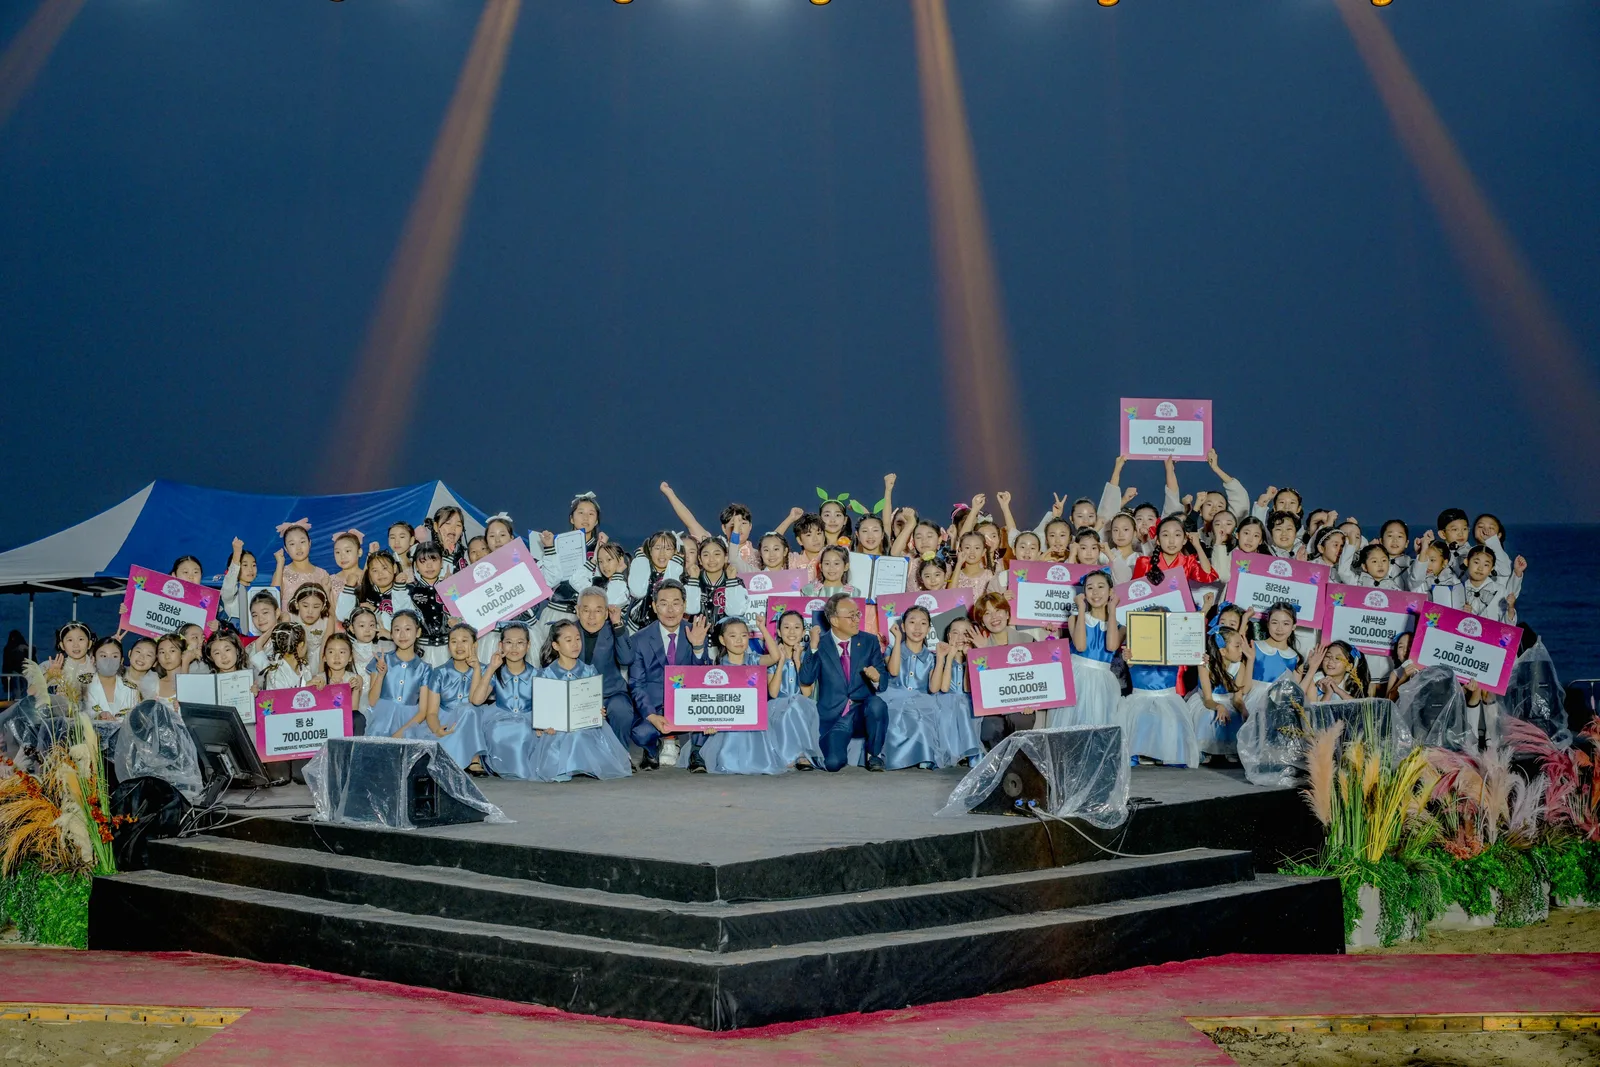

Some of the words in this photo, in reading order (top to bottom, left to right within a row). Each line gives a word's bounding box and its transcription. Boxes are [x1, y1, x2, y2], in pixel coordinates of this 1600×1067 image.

[1142, 436, 1191, 445] 1,000,000원
[1045, 589, 1070, 599] 새싹상
[1265, 582, 1290, 594] 장려상
[476, 583, 525, 616] 1,000,000원
[158, 602, 181, 616] 장려상
[1361, 615, 1387, 626] 새싹상
[1348, 625, 1397, 640] 300,000원
[1433, 648, 1489, 672] 2,000,000원
[1008, 671, 1034, 681] 지도상
[998, 681, 1048, 696] 500,000원
[690, 694, 741, 702] 붉은노을대상
[688, 705, 745, 715] 5,000,000원
[282, 729, 328, 742] 700,000원
